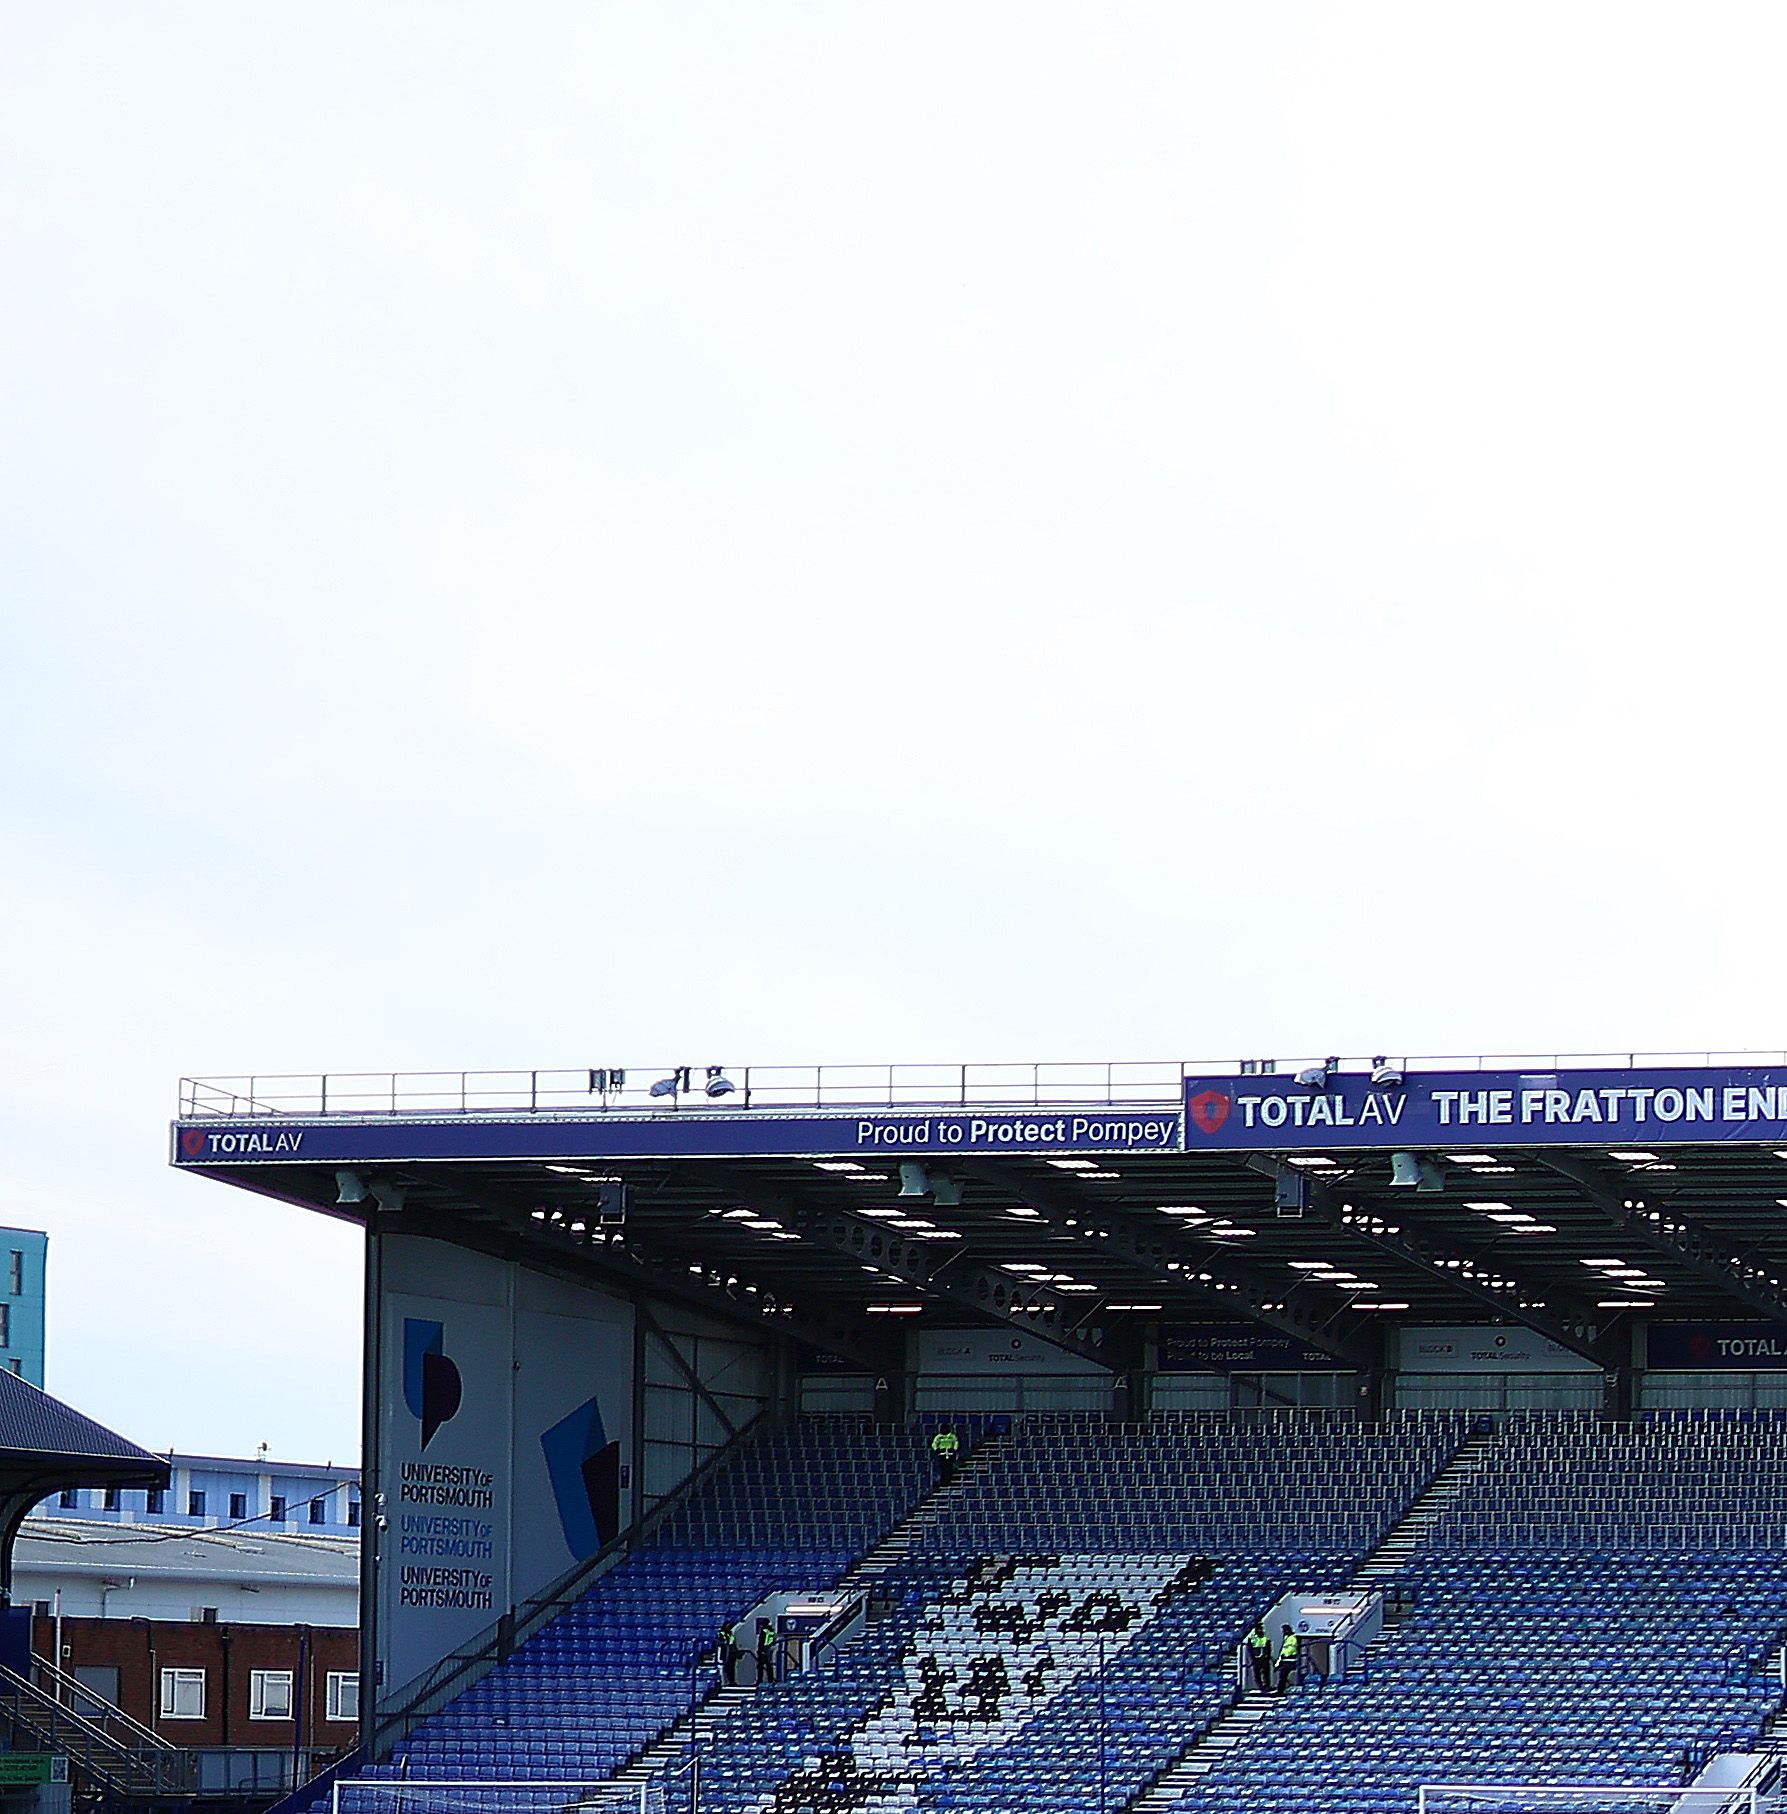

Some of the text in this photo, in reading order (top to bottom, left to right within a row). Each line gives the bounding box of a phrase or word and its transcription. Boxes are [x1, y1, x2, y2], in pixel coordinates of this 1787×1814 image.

[1432, 1091, 1513, 1125] THE
[1521, 1088, 1713, 1123] FRATTON
[858, 1118, 1174, 1145] Proud to Protect Pompey
[874, 1376, 889, 1391] A
[401, 1484, 493, 1508] PORTSMOUTH
[401, 1536, 493, 1559] PORTSMOUTH
[401, 1587, 493, 1609] PORTSMOUTH
